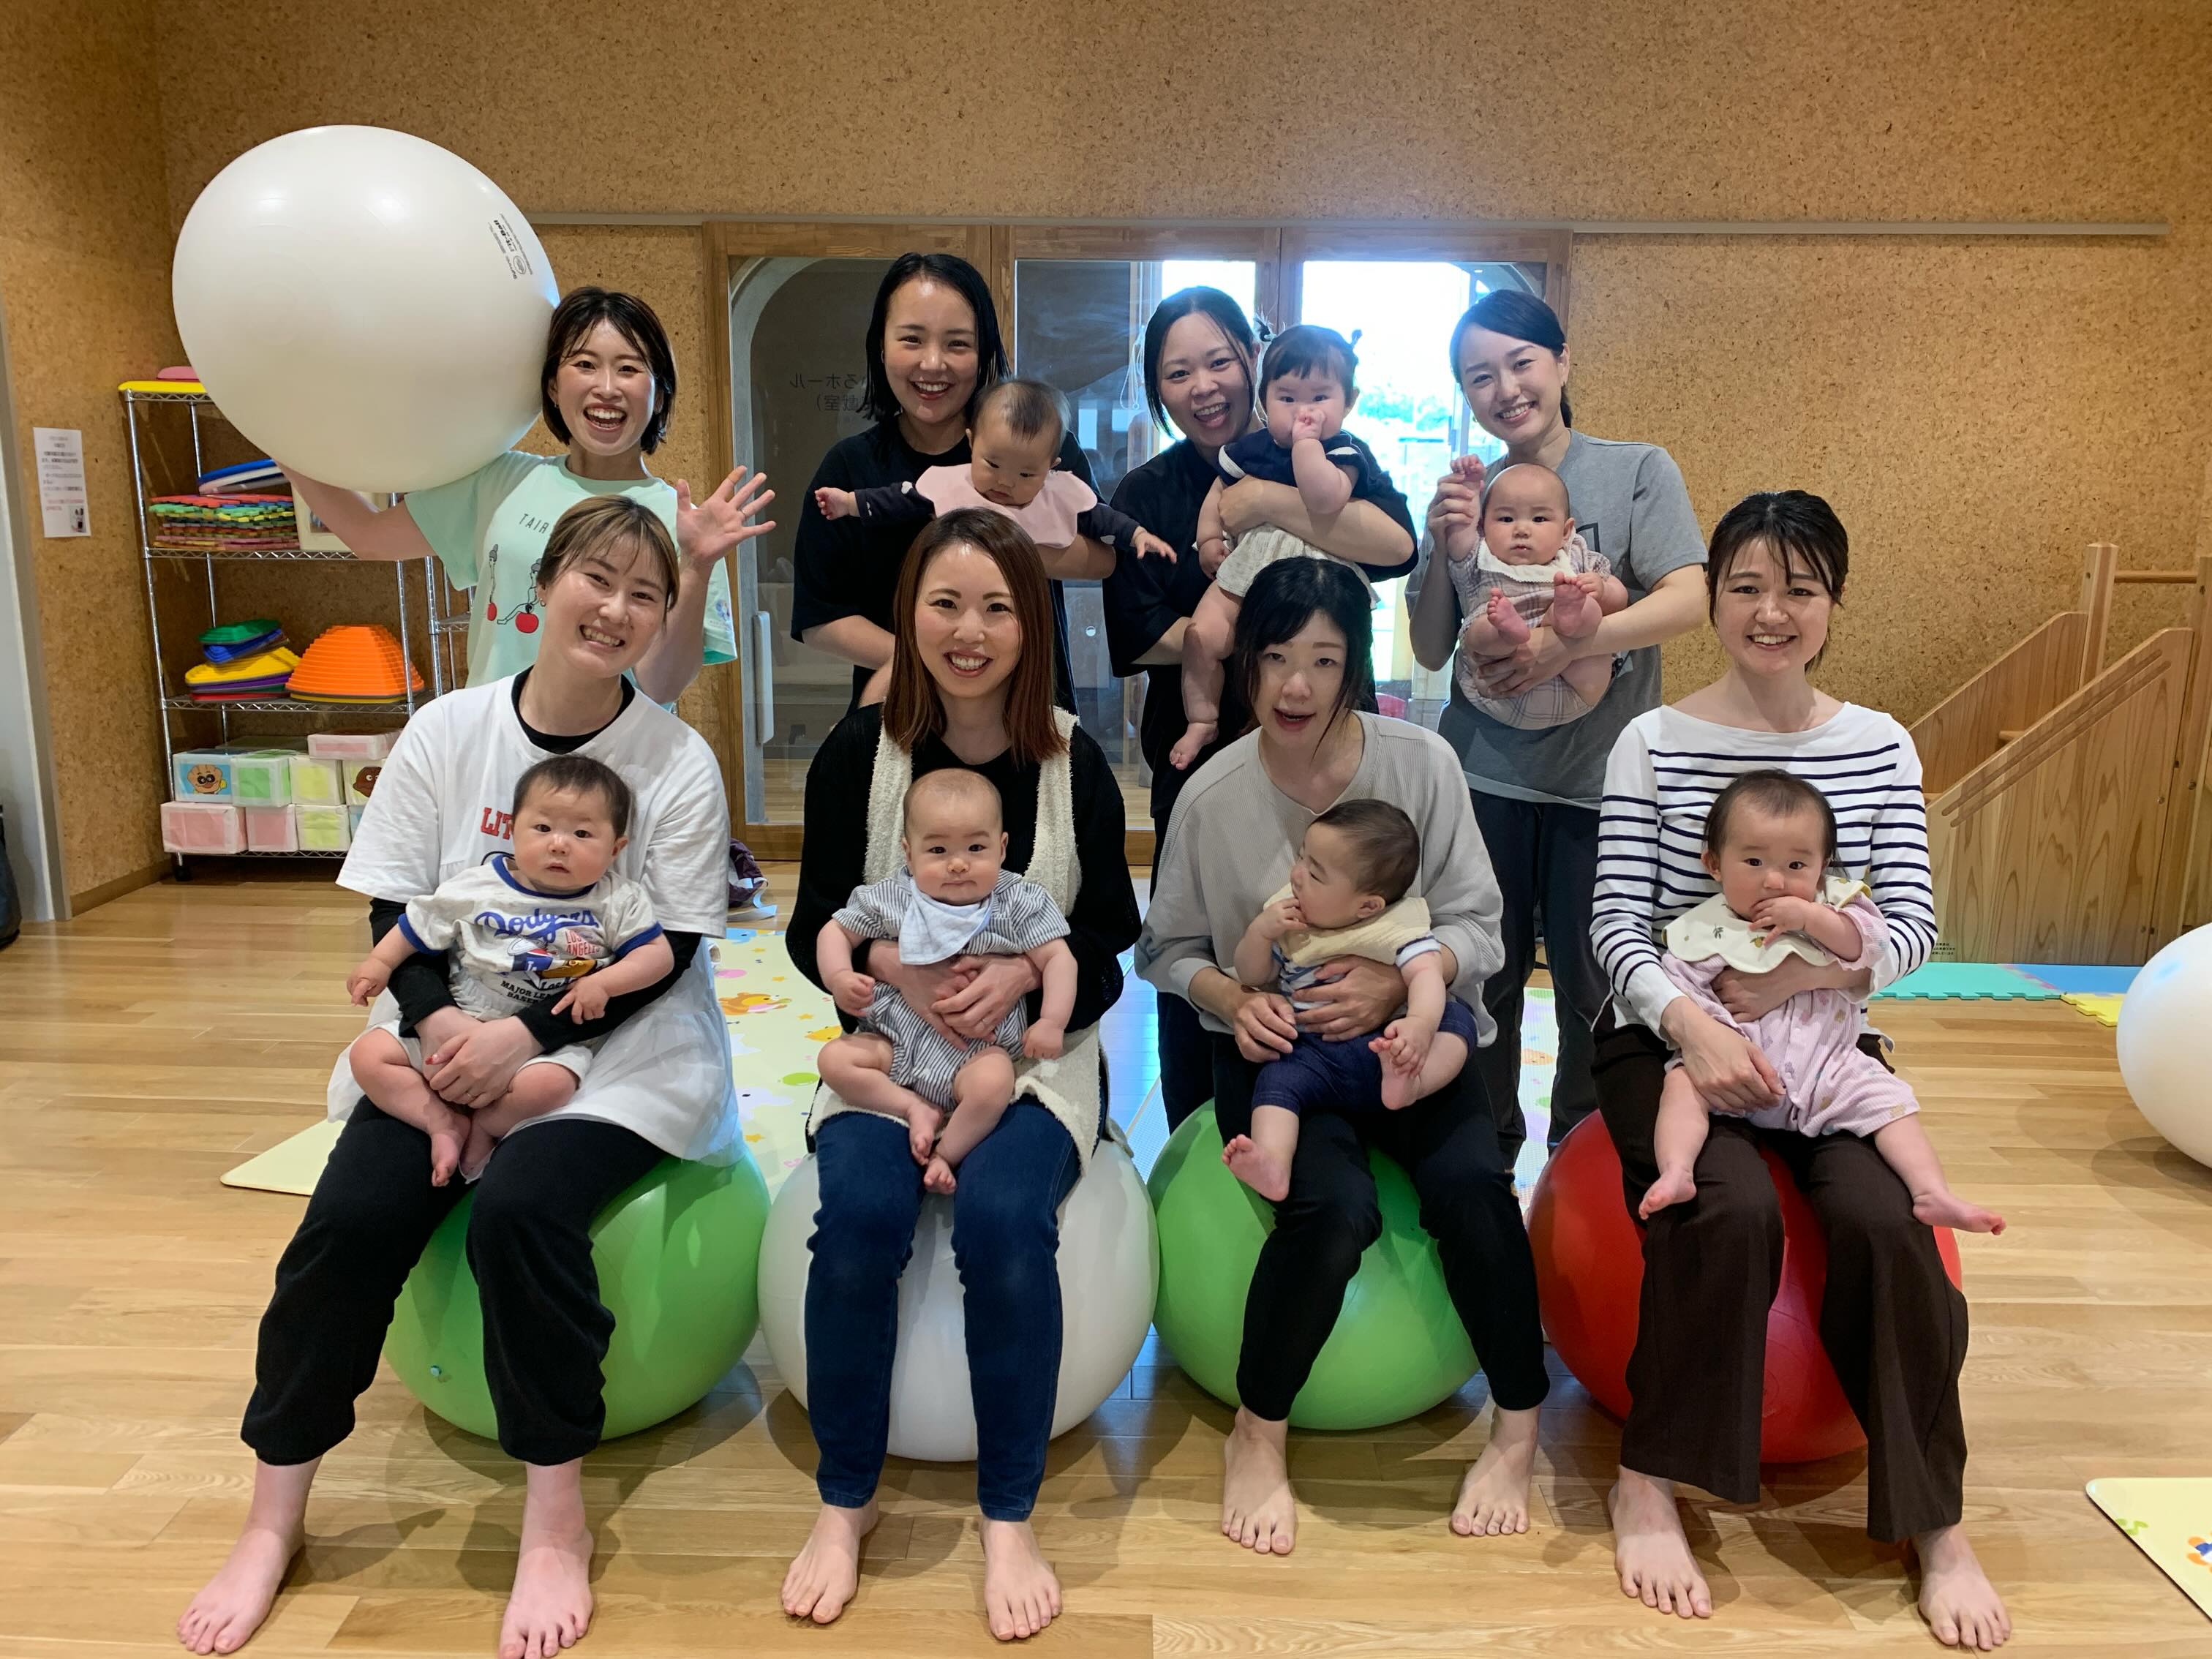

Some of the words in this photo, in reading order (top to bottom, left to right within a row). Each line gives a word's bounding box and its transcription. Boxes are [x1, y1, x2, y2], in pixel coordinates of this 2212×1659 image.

[519, 513, 549, 534] TAIR
[473, 908, 599, 943] Dodgers
[500, 980, 532, 996] MAJOR
